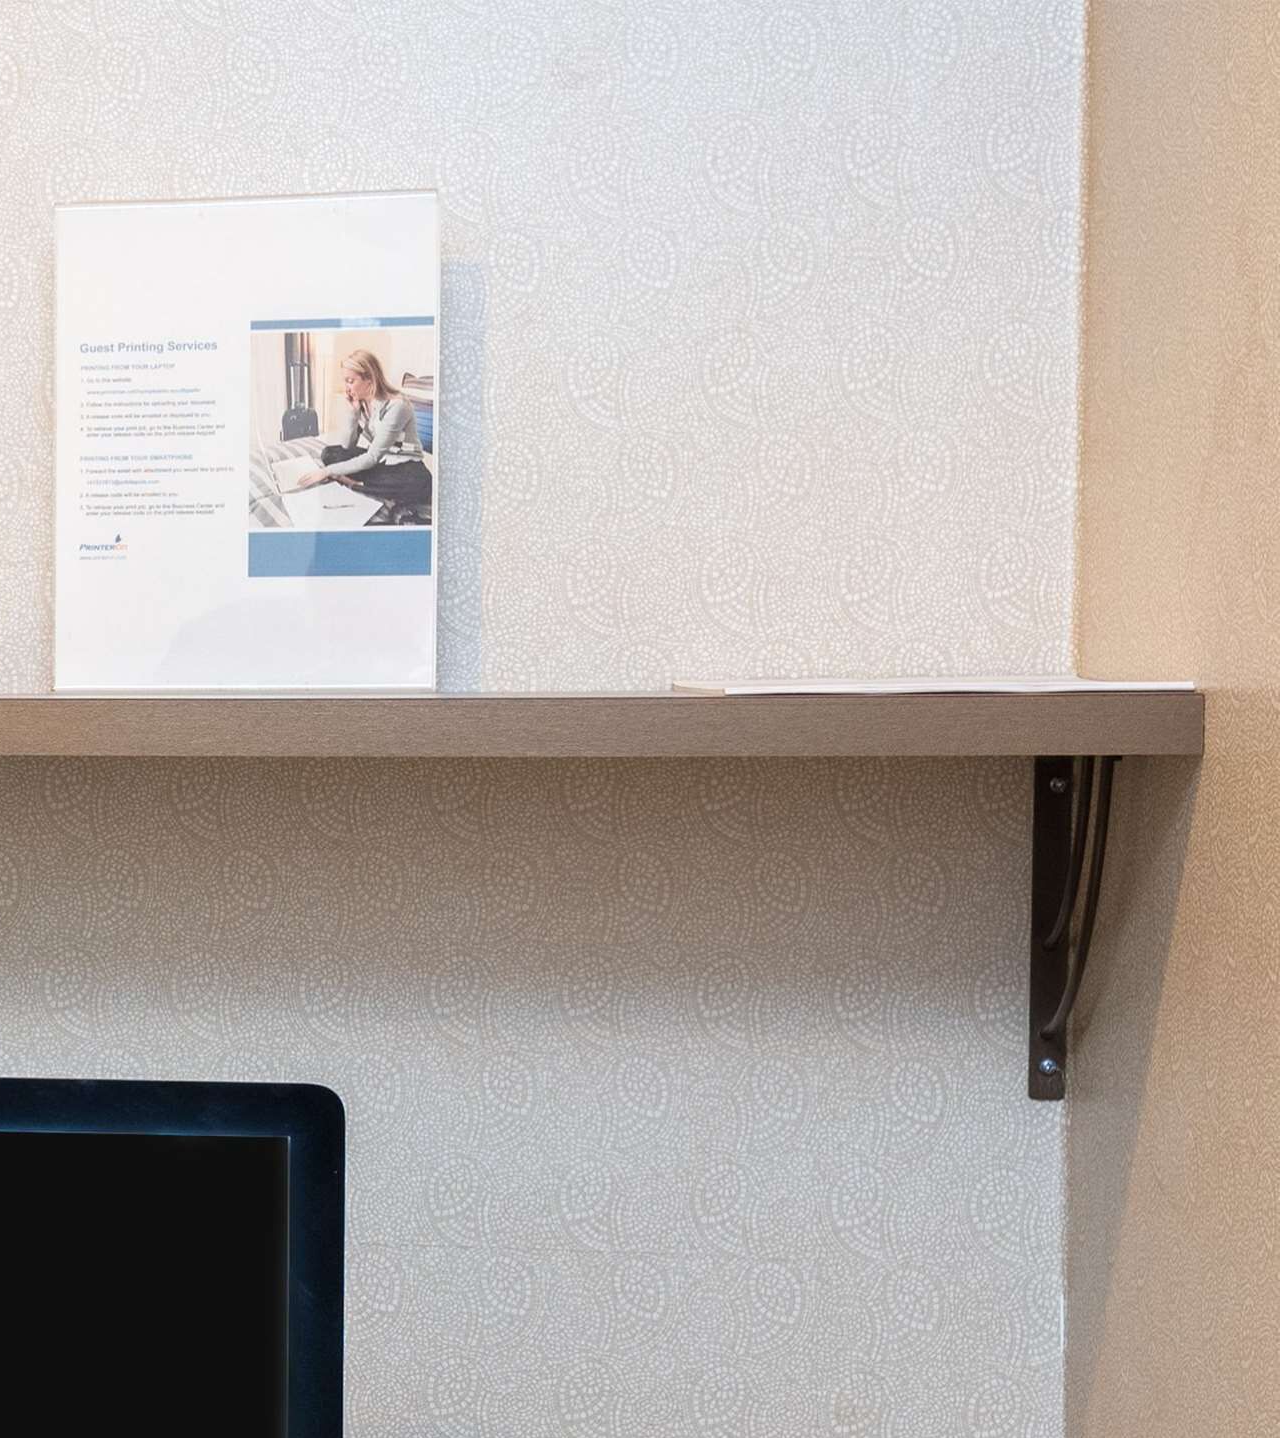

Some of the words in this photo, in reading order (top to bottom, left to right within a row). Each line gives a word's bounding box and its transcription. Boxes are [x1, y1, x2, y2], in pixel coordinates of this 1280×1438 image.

[79, 343, 114, 354] Guest
[117, 341, 164, 355] Printing
[167, 340, 218, 352] Services
